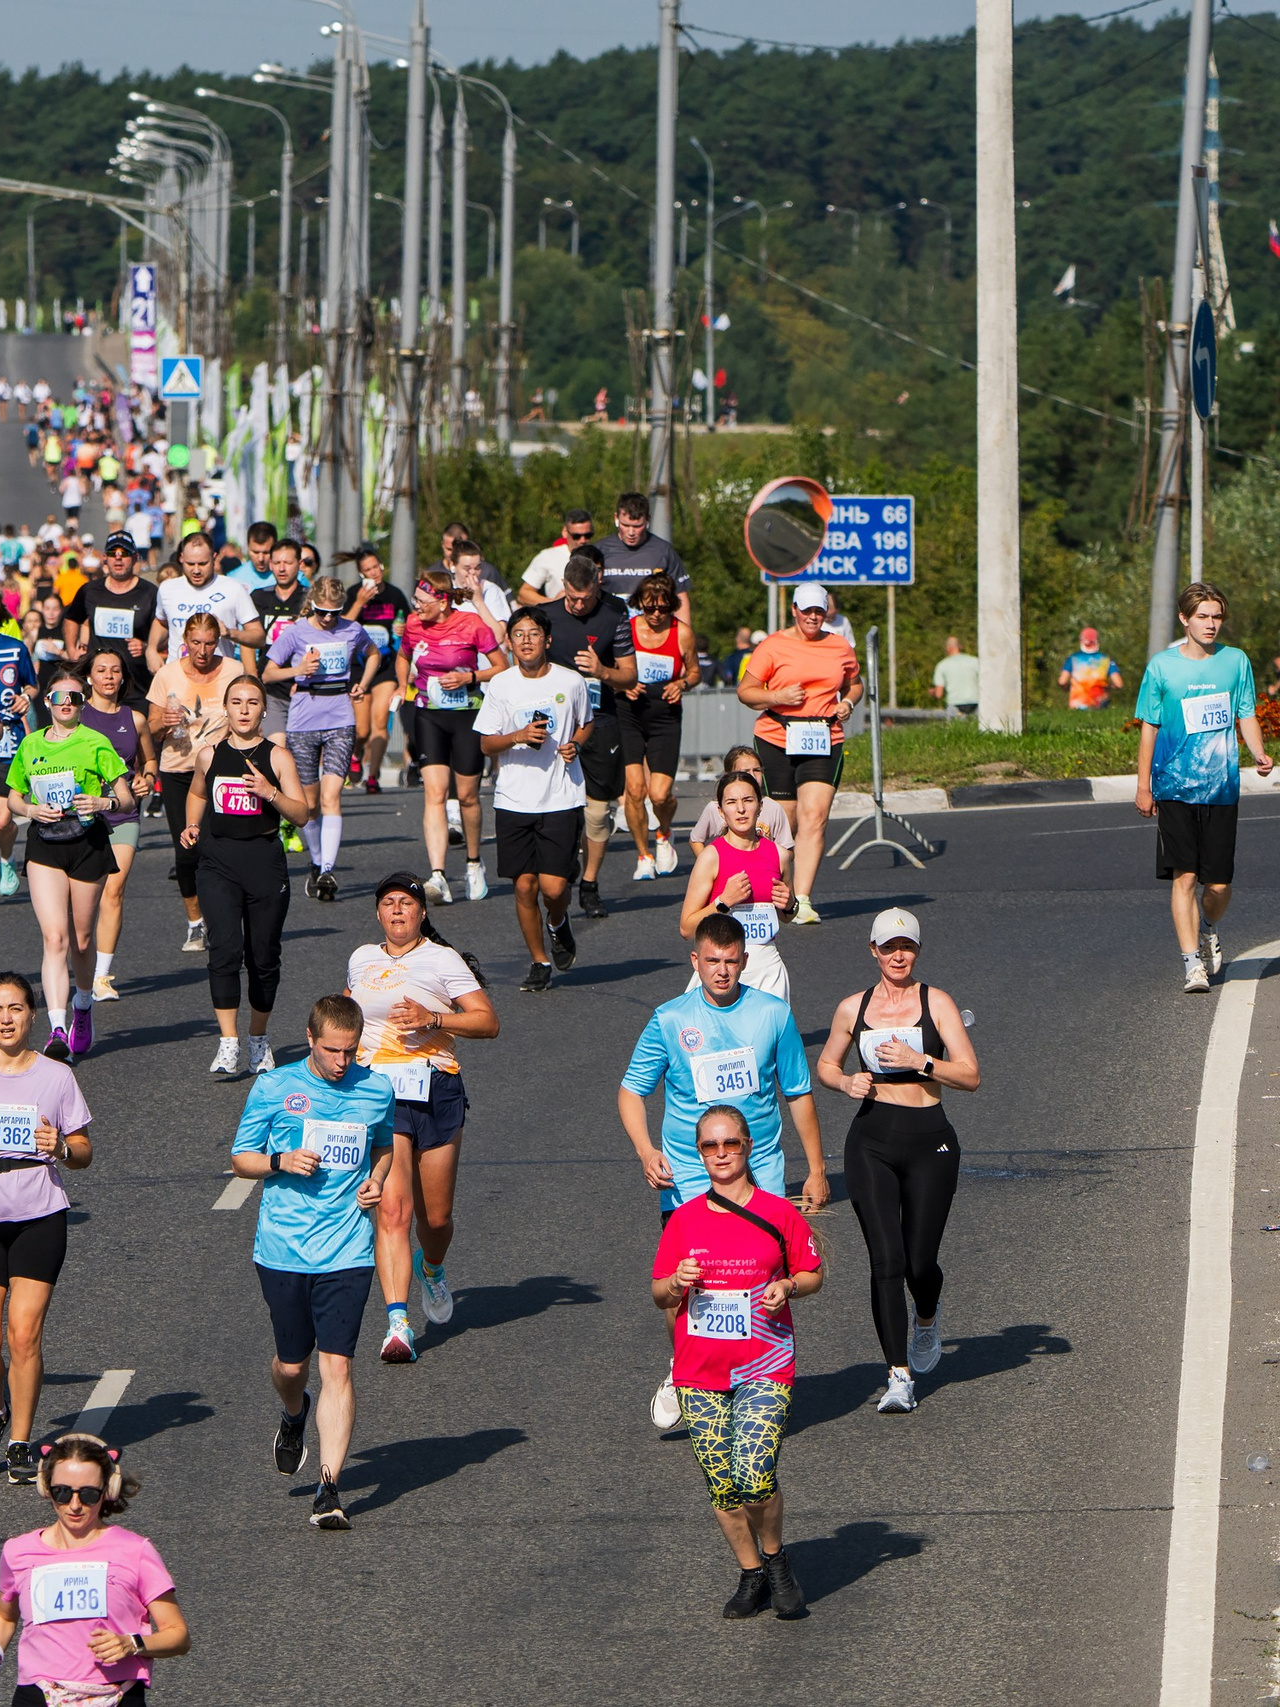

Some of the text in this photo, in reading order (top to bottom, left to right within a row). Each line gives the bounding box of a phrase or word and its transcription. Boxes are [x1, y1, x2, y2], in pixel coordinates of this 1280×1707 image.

[131, 293, 155, 327] 21
[882, 505, 908, 524] 66
[872, 532, 908, 550] 196
[872, 556, 908, 575] 216
[107, 622, 130, 634] 3516
[321, 657, 346, 670] 3228
[644, 668, 669, 681] 3405
[441, 691, 465, 704] 2446
[1204, 702, 1222, 711] СТЕПАН
[1201, 710, 1229, 726] 4735
[801, 738, 826, 750] 3314
[47, 789, 72, 804] 4932
[228, 795, 258, 811] 4780
[745, 913, 769, 922] ТАТЬЯНА
[718, 1060, 746, 1072] ФИЛИПП
[716, 1070, 753, 1092] 3451
[327, 1133, 357, 1145] ВИТАЛИЙ
[322, 1145, 359, 1165] 2960
[709, 1303, 739, 1312] ЕВГЕНИЯ
[706, 1313, 745, 1333] 2208
[63, 1576, 89, 1587] ИРИНА
[53, 1588, 99, 1612] 4136
